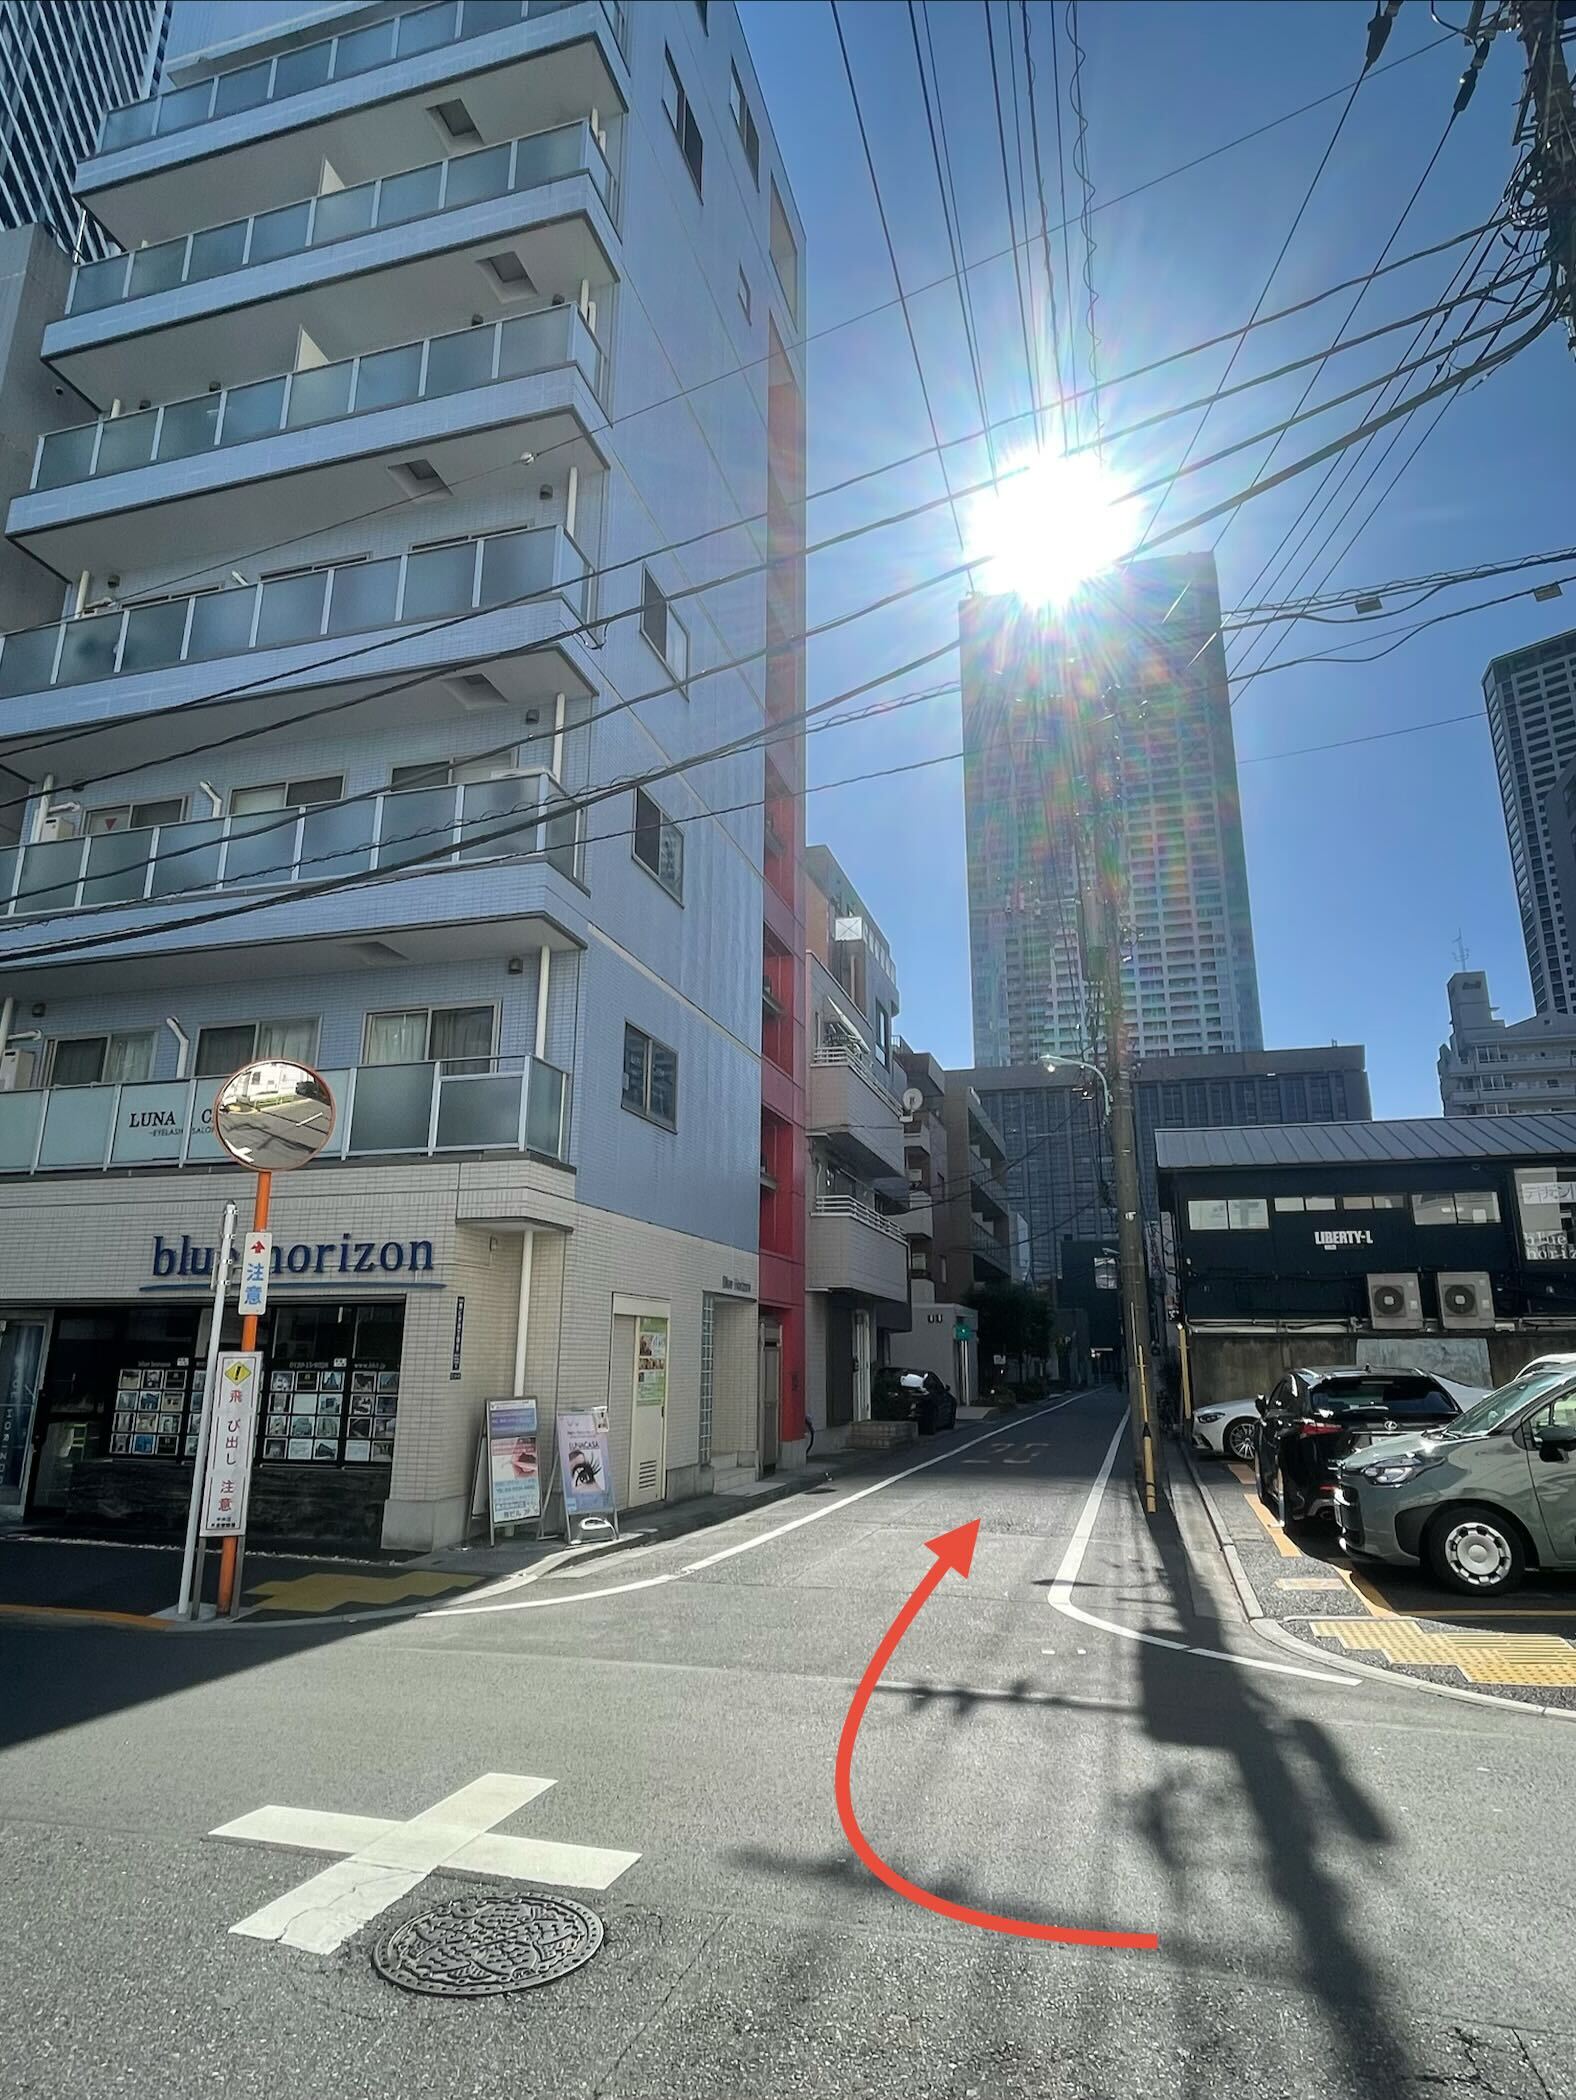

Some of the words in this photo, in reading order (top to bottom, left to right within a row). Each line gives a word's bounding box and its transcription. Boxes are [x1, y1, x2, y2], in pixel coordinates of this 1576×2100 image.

[129, 1111, 176, 1128] LUNA
[1314, 1230, 1374, 1245] LIBERTY-L
[244, 1263, 264, 1305] 注意
